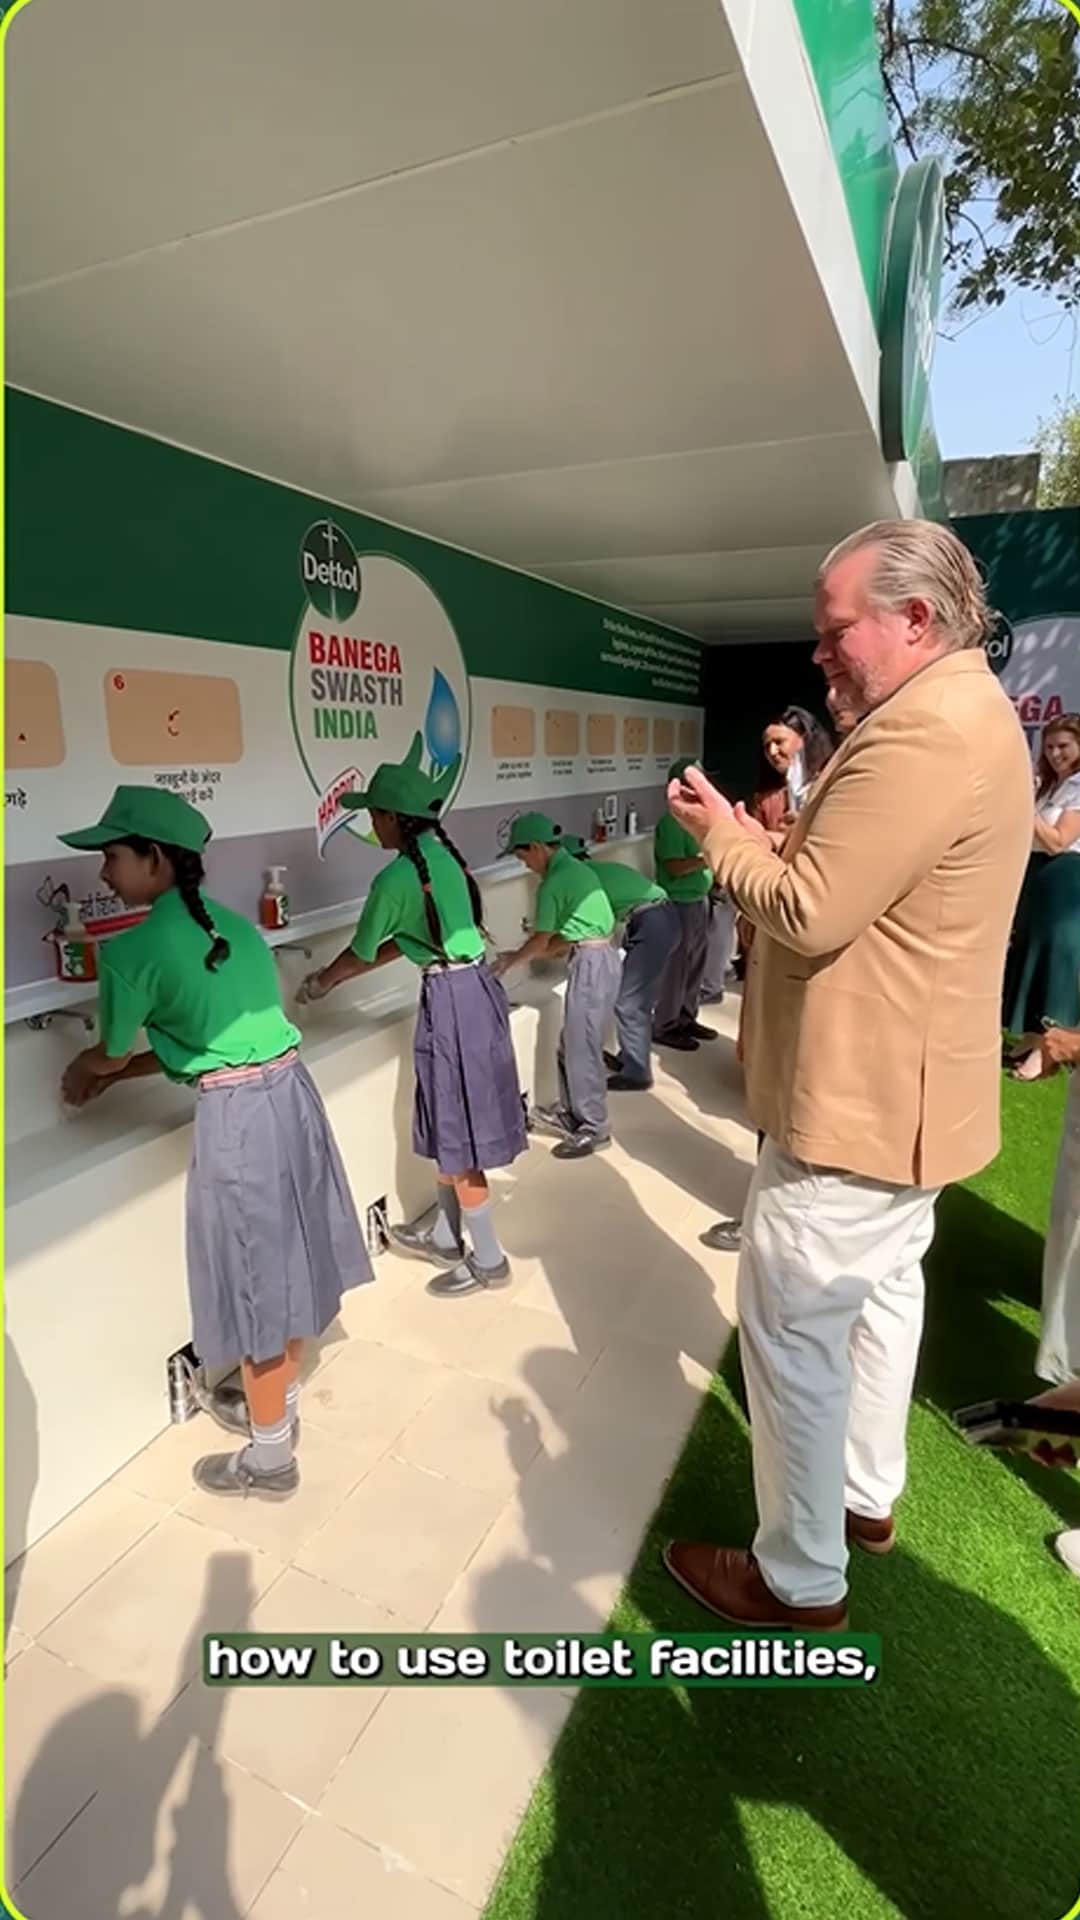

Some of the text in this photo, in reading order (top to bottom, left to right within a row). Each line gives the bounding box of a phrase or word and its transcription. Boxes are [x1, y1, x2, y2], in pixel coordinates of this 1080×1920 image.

[303, 552, 358, 591] Dettol
[309, 631, 402, 674] BANEGA
[113, 674, 125, 690] 6
[311, 669, 403, 706] SWASTH
[314, 708, 378, 739] INDIA
